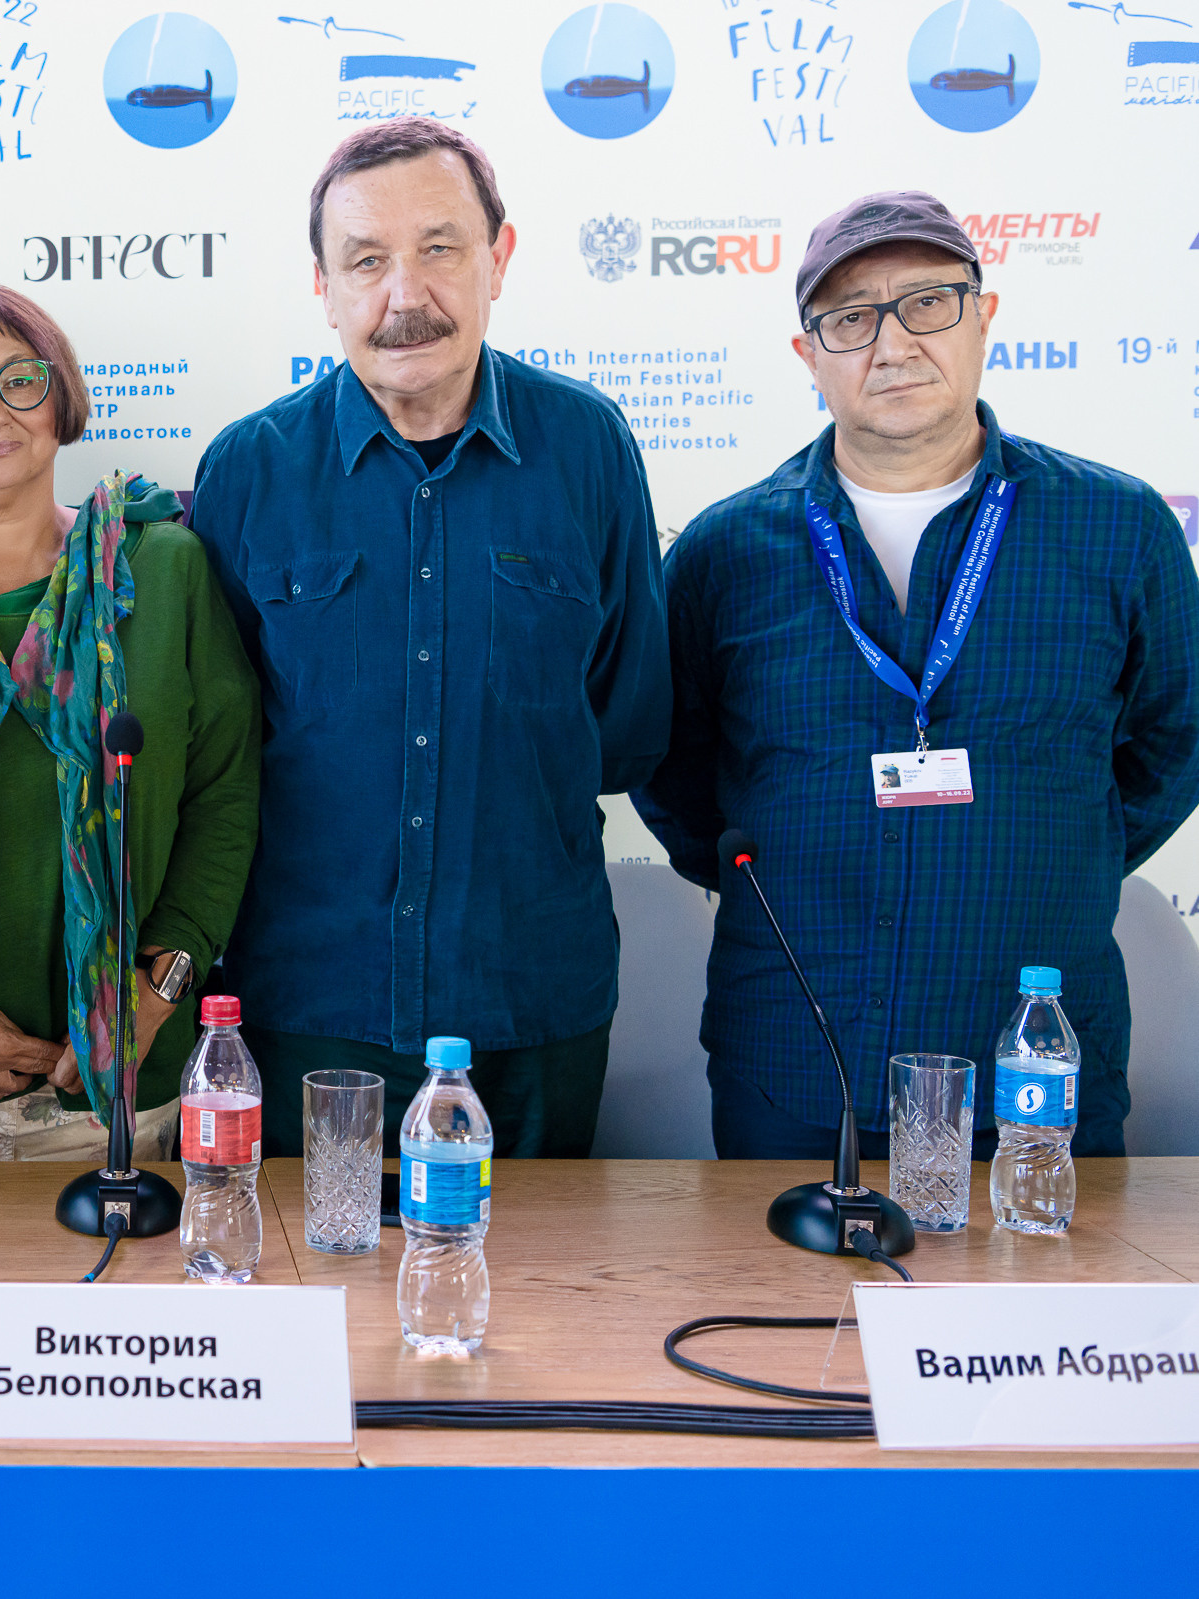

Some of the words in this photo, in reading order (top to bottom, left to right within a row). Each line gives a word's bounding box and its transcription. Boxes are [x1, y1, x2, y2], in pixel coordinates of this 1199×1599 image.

[1125, 76, 1199, 92] PACIFI
[338, 89, 424, 107] PACIFIC
[763, 113, 834, 147] VAL
[651, 216, 735, 230] Российская
[738, 215, 781, 229] Газета
[651, 234, 781, 277] RG.RU
[1018, 242, 1081, 253] ПРИМОРЬЕ
[589, 347, 728, 365] International
[83, 358, 189, 378] народный
[588, 371, 631, 386] Film
[640, 369, 722, 385] Festival
[617, 393, 673, 408] Asian
[682, 390, 754, 406] Pacific
[630, 413, 691, 428] ntries
[82, 426, 192, 442] дивостоке
[637, 433, 739, 450] adivostok
[980, 504, 995, 528] Pacific
[982, 507, 1003, 554] International
[967, 531, 985, 566] Countries
[975, 556, 987, 571] Film
[964, 573, 980, 603] Festival
[948, 578, 969, 621] Vladivostok
[953, 614, 965, 635] Asian
[35, 1326, 217, 1364] Виктория
[915, 1348, 1045, 1384] Вадим
